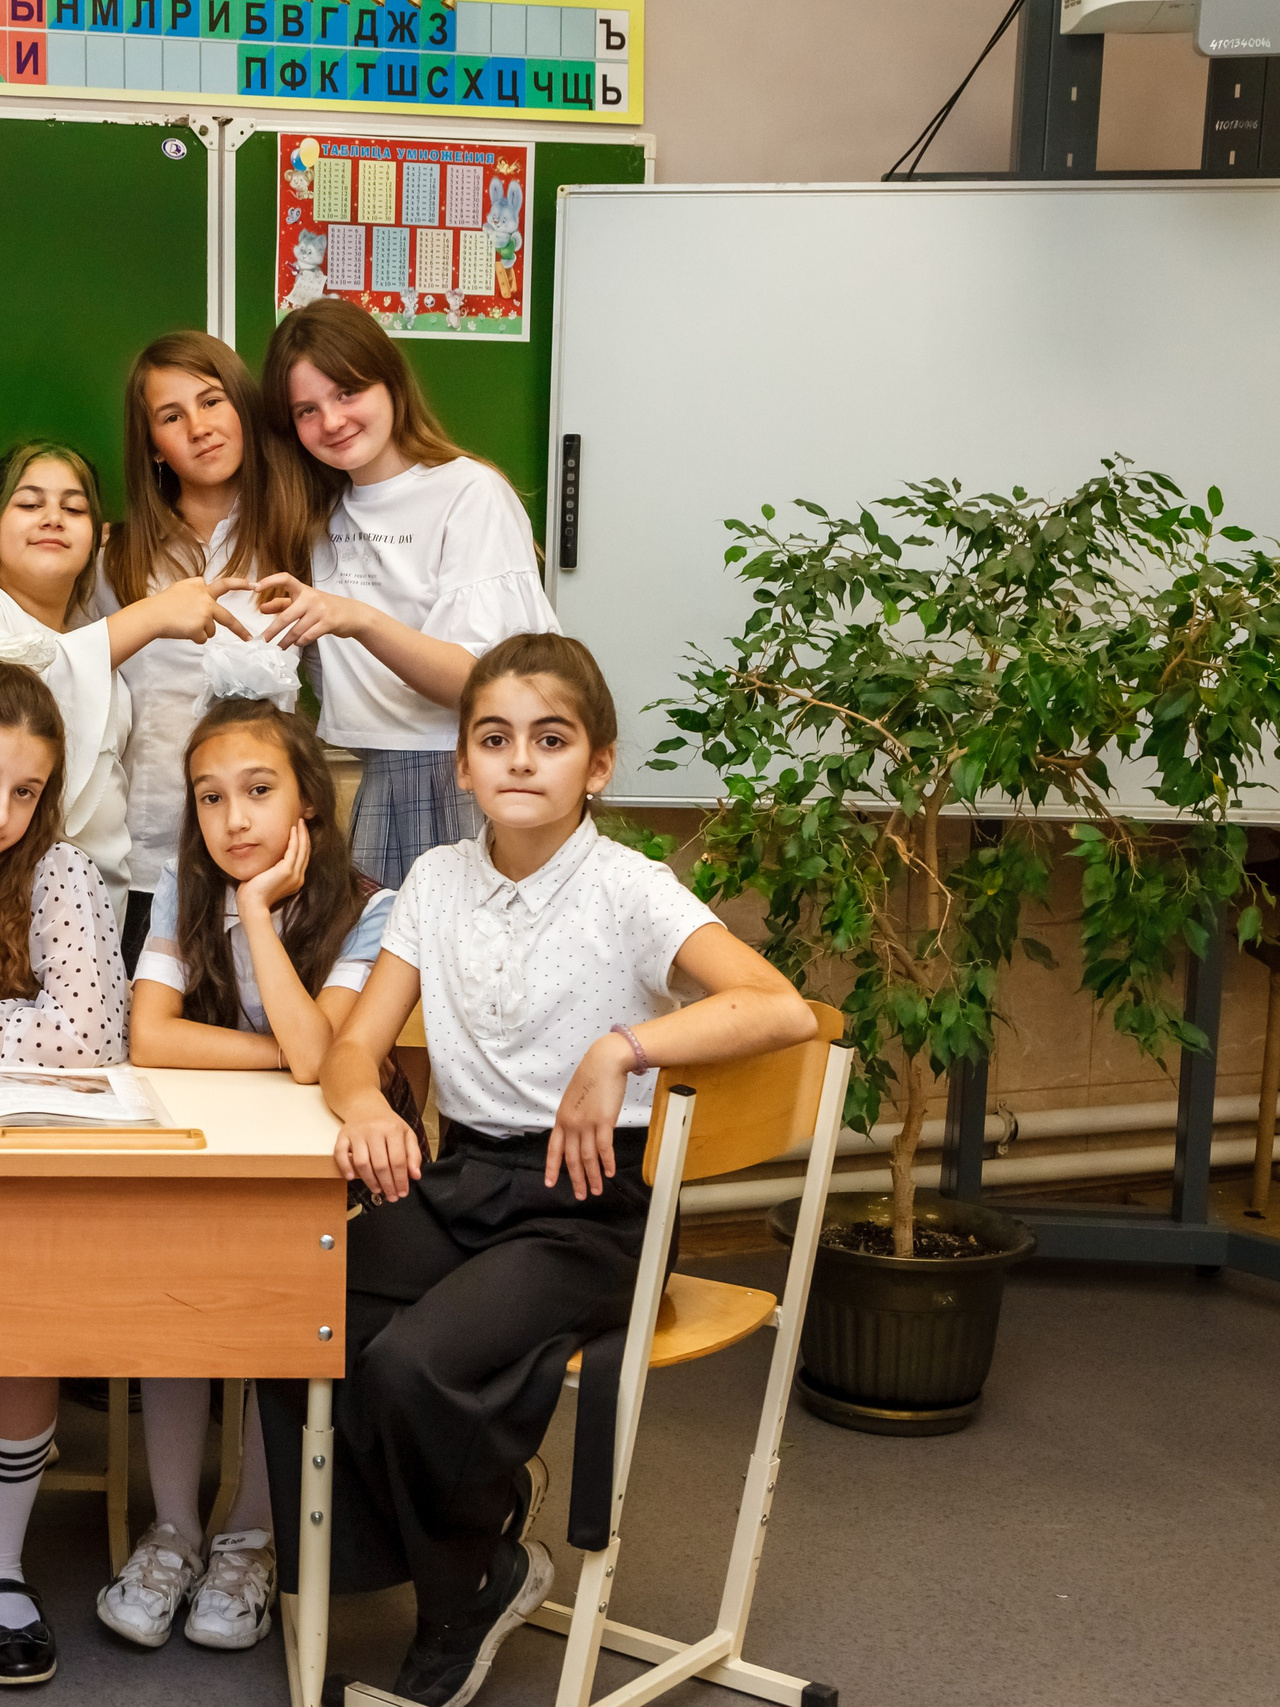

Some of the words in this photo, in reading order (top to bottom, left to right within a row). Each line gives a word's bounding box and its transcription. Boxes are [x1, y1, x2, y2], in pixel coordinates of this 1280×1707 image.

[12, 0, 44, 22] Ы
[57, 0, 78, 25] Н
[92, 0, 118, 27] М
[132, 0, 154, 28] Л
[172, 0, 191, 30] Р
[246, 3, 267, 35] Б
[282, 5, 304, 37] В
[322, 7, 339, 39] Г
[354, 9, 379, 47] Д
[388, 11, 418, 43] Ж
[429, 13, 448, 45] З
[599, 18, 626, 51] Ъ
[16, 41, 39, 76] И
[245, 57, 267, 90] П
[279, 59, 307, 92] Ф
[320, 61, 340, 93] К
[356, 63, 377, 95] Т
[387, 64, 417, 97] Ш
[427, 66, 449, 99] С
[463, 67, 485, 100] Х
[497, 69, 520, 108] Ц
[534, 71, 554, 103] Ч
[563, 72, 594, 111] Щ
[602, 74, 623, 106] Ь
[321, 144, 392, 160] ТАБЛИЦА
[396, 147, 495, 165] УМНОЖЕНИЯ
